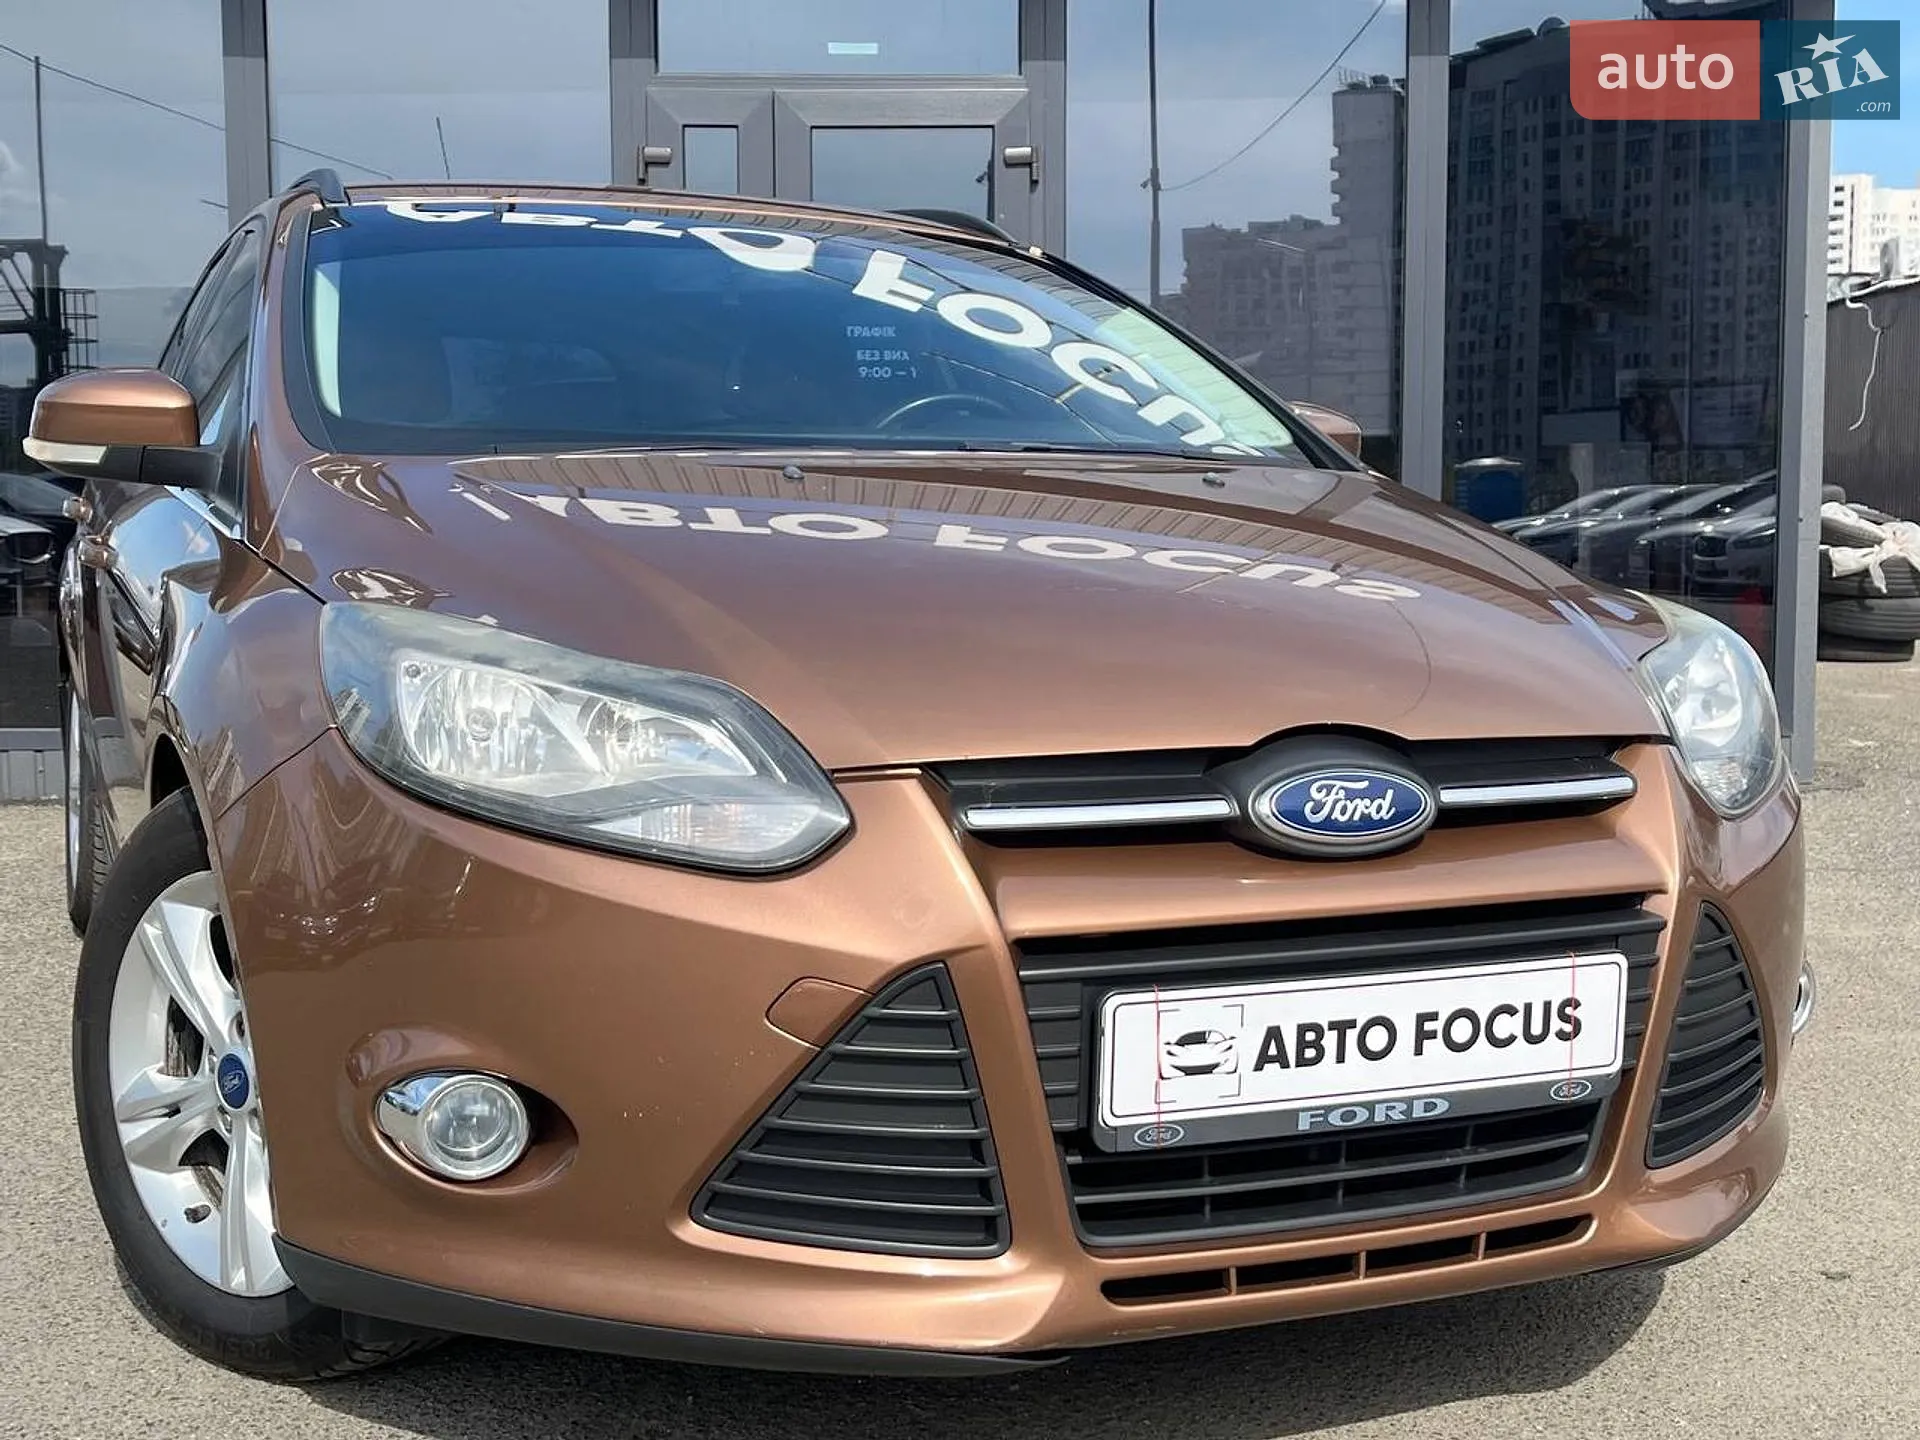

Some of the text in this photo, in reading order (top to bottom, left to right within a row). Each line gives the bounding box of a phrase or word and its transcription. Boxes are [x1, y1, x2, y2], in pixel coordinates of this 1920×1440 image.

[856, 349, 880, 361] БЕЗ
[858, 366, 892, 378] 9:00
[1304, 780, 1396, 823] Ford
[1413, 997, 1583, 1057] FOCUS
[1296, 1097, 1451, 1131] FORD
